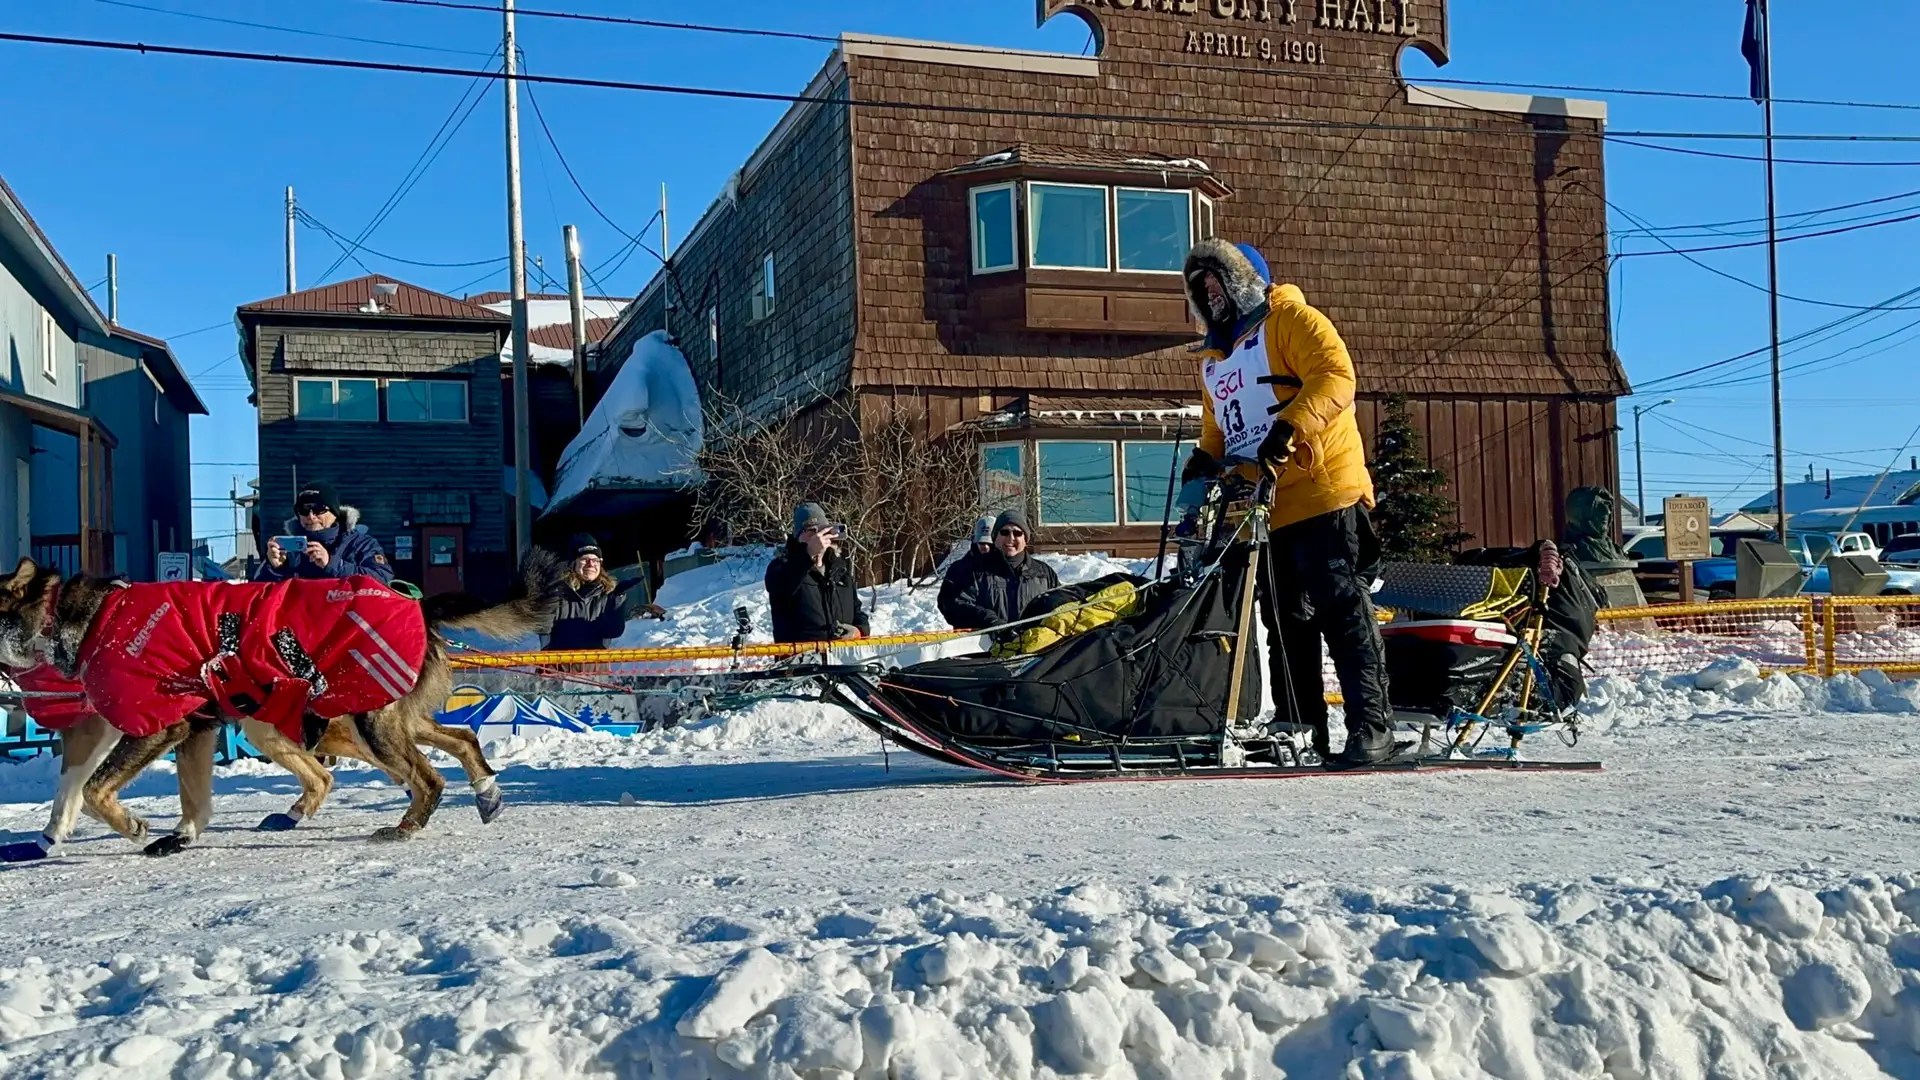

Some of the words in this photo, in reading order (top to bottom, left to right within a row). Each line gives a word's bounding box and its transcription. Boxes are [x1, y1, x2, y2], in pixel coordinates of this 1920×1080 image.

[1320, 0, 1418, 36] HALL
[1186, 30, 1251, 57] APRIL
[1261, 37, 1277, 63] 9,
[1284, 39, 1326, 64] 1901
[1215, 368, 1244, 400] GCI
[1223, 399, 1245, 436] 13
[125, 602, 170, 656] Non-stop
